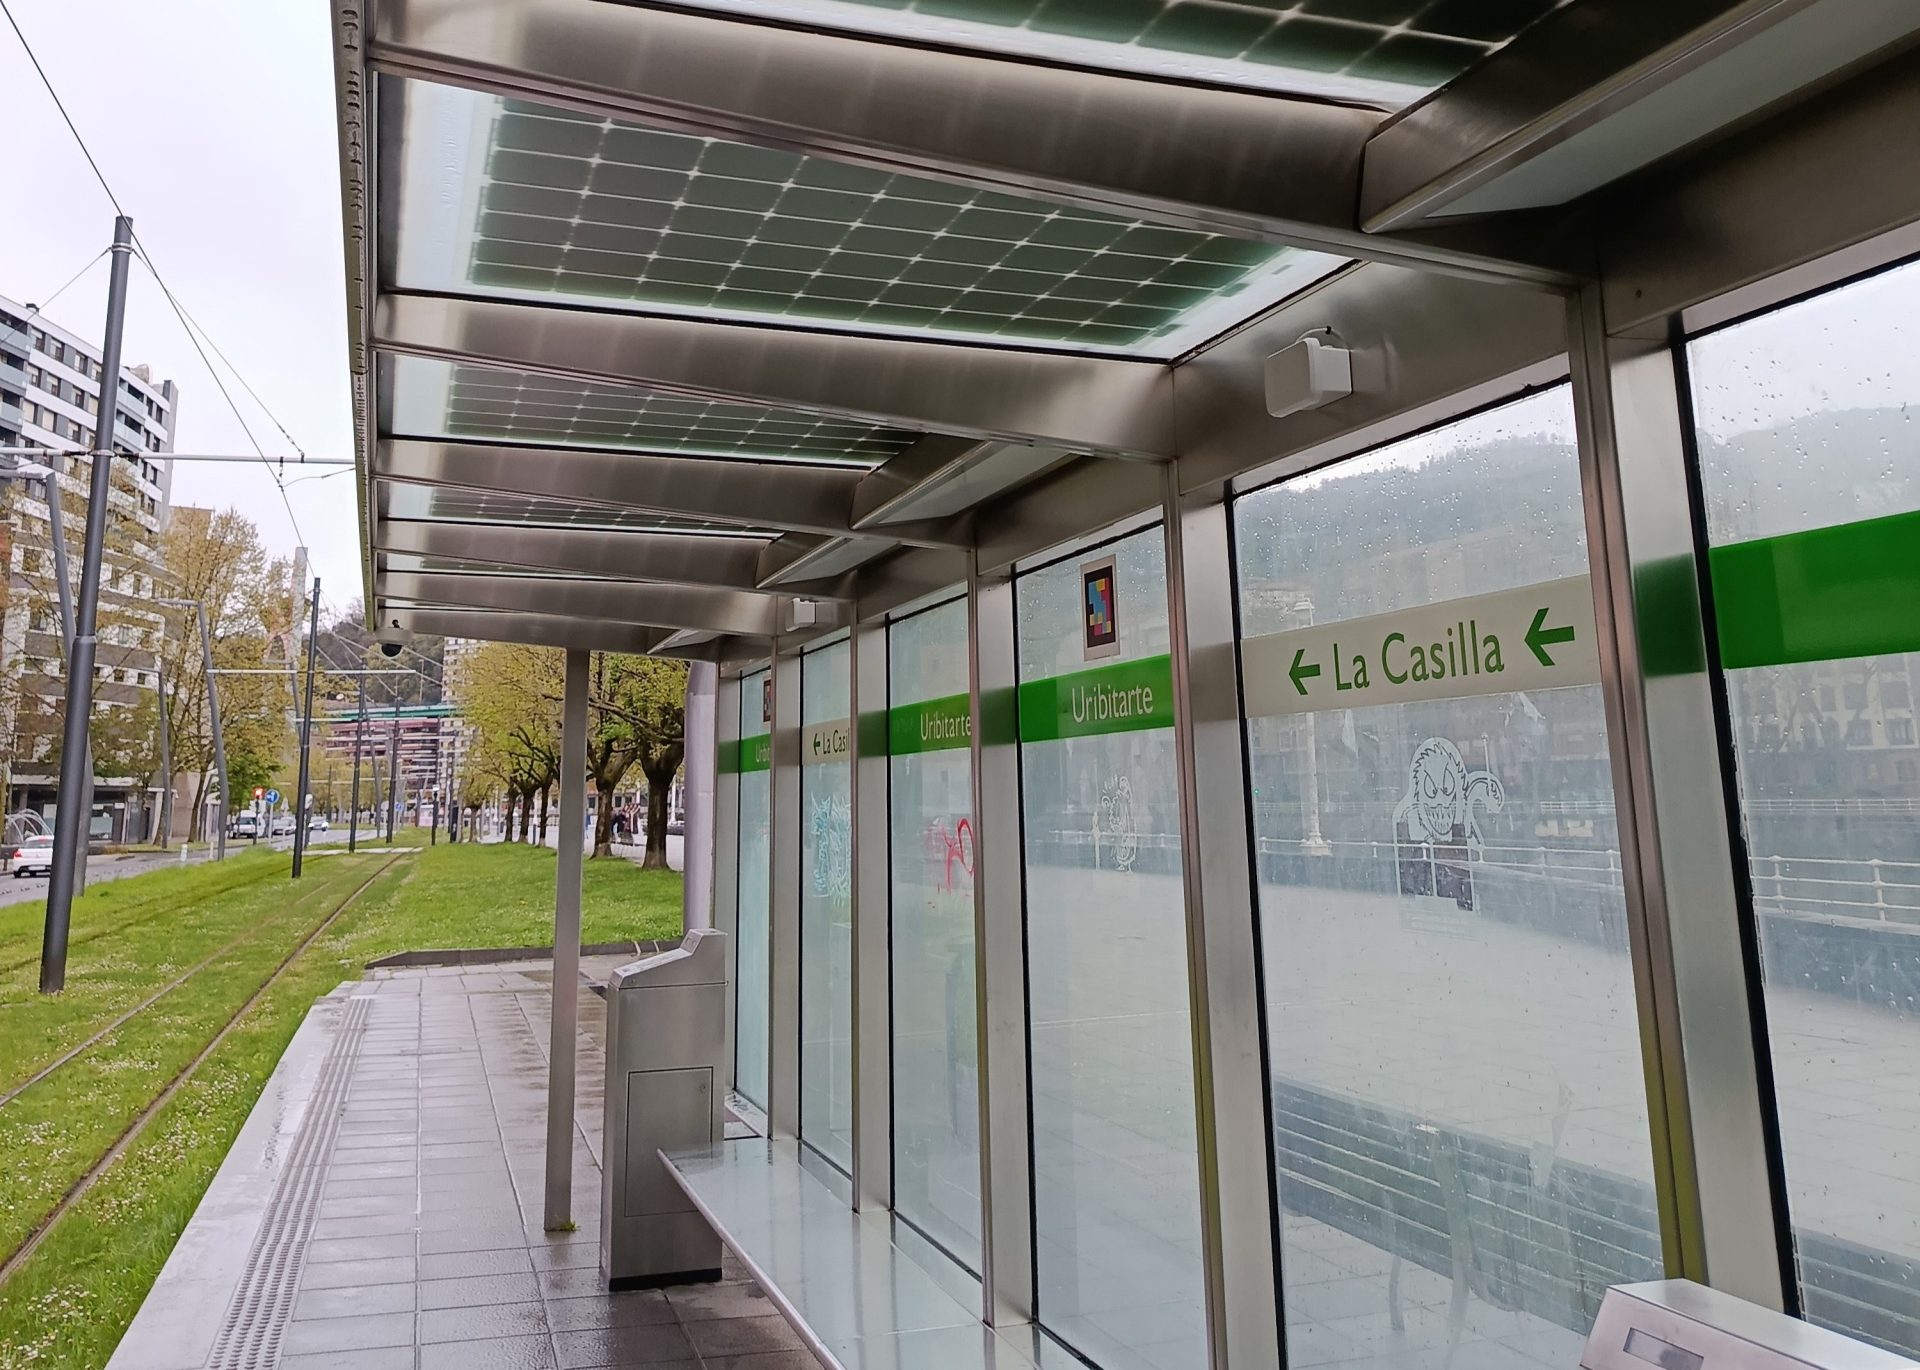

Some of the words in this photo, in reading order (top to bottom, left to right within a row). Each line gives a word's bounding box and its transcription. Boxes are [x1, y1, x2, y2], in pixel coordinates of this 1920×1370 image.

[1333, 643, 1370, 691] La
[1381, 619, 1505, 685] Casilla
[1071, 683, 1154, 723] Uribitarte
[822, 732, 831, 755] La
[920, 711, 972, 741] Uribitarte
